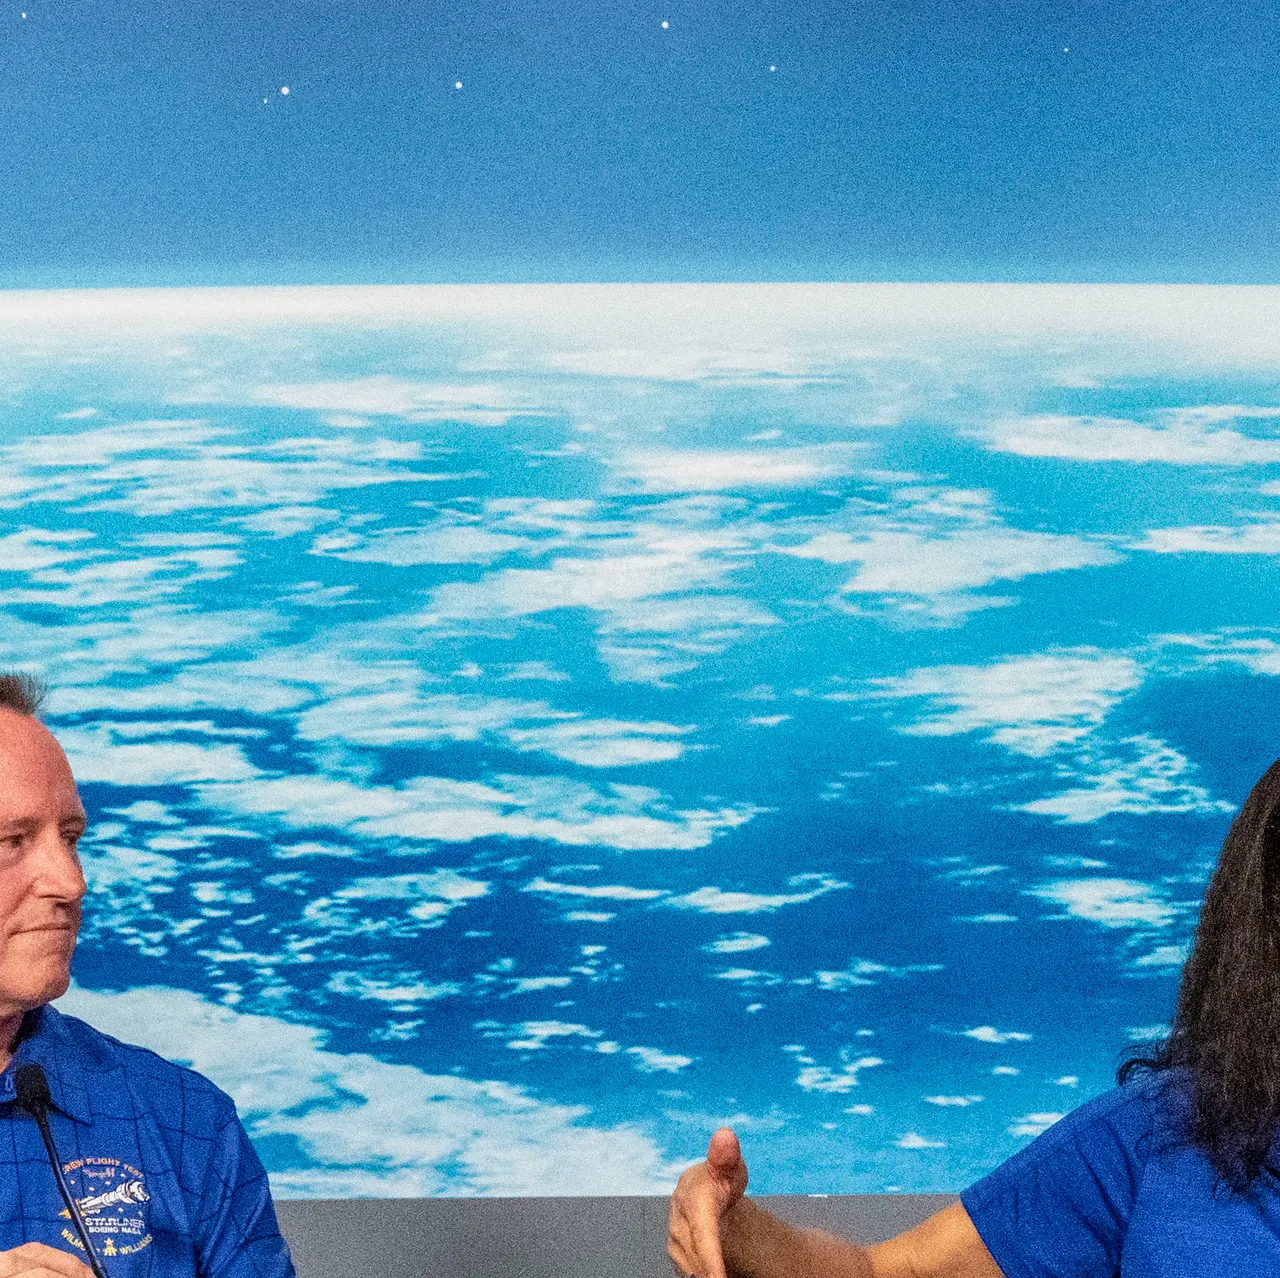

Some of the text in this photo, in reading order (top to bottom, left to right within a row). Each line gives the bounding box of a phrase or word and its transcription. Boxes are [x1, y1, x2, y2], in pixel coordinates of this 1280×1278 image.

[61, 1160, 84, 1174] REW
[84, 1217, 145, 1229] STARLINER
[119, 1233, 153, 1255] WILLIAMS
